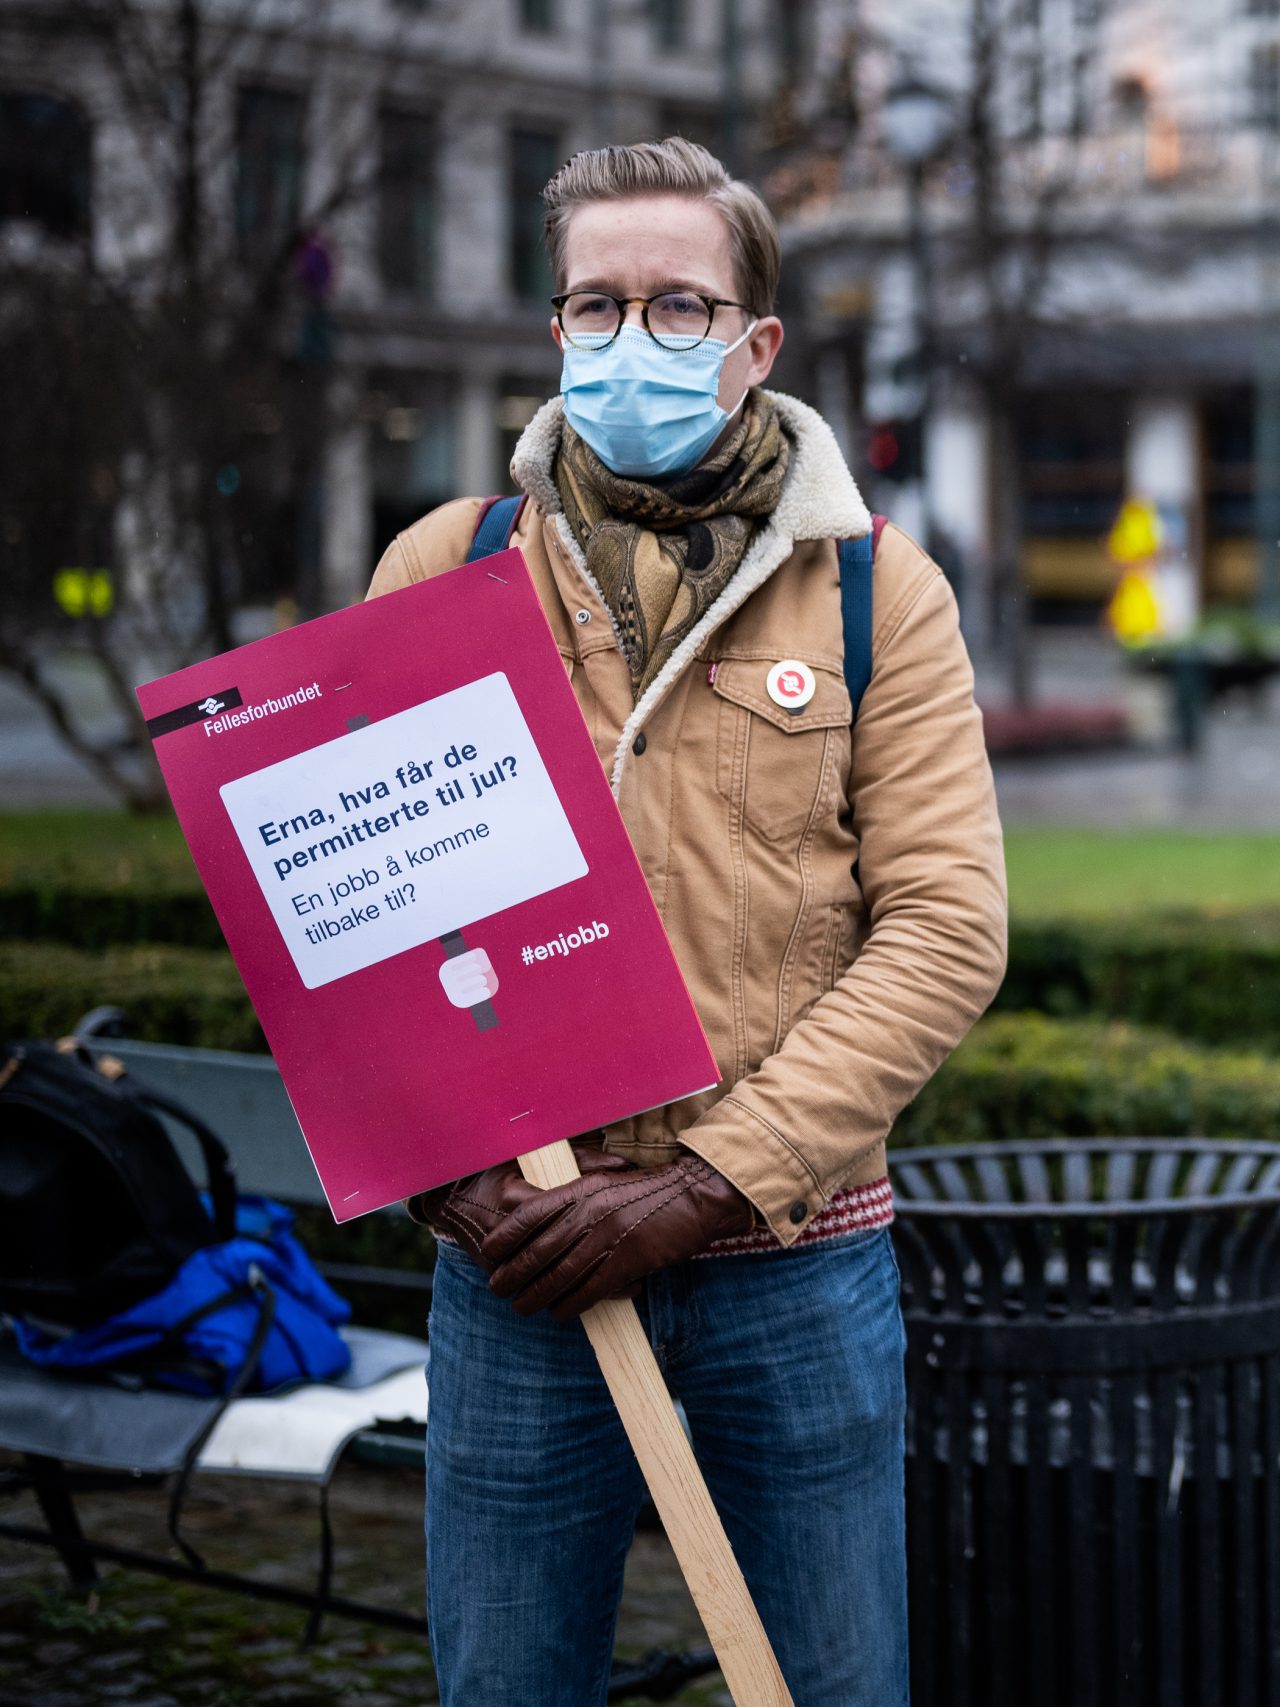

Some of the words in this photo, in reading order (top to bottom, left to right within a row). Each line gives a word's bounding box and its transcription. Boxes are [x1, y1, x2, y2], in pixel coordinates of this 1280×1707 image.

[203, 682, 323, 738] Fellesforbundet
[258, 807, 335, 847] Erna,
[338, 780, 391, 813] hva
[394, 758, 435, 790] får
[442, 741, 478, 769] de
[273, 799, 431, 882] permitterte
[435, 779, 465, 807] til
[469, 755, 519, 799] jul?
[291, 893, 325, 917] En
[327, 868, 380, 907] jobb
[385, 855, 403, 877] å
[404, 821, 491, 868] komme
[303, 903, 380, 945] tilbake
[384, 882, 417, 911] til?
[521, 920, 610, 966] #enjobb
